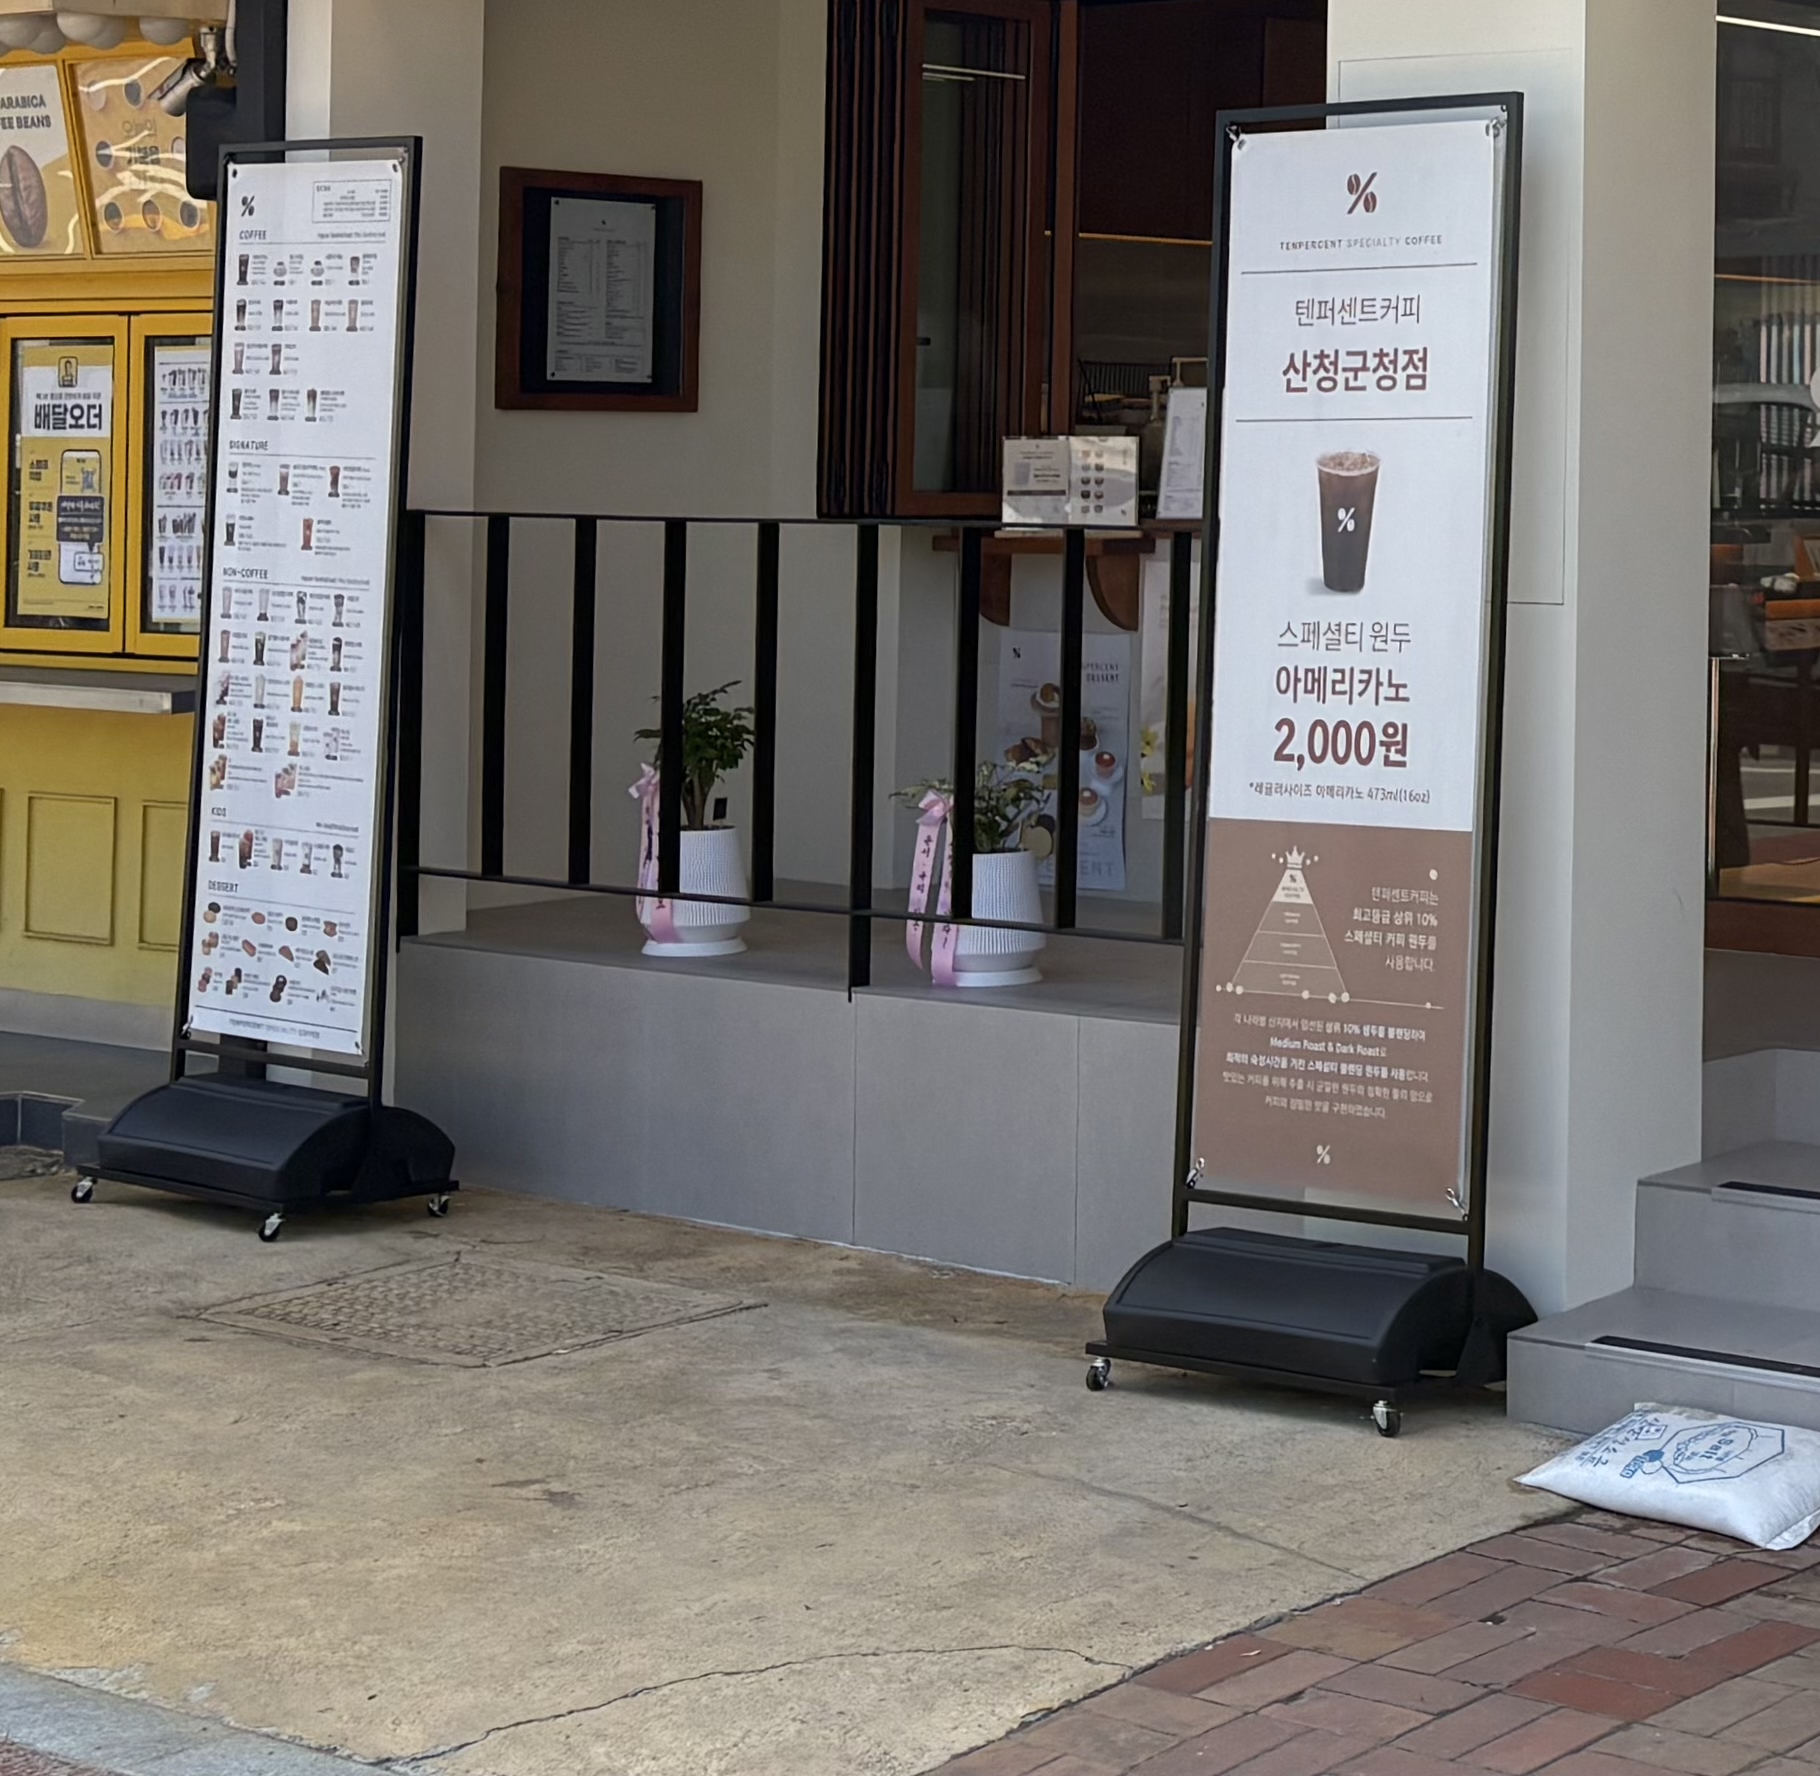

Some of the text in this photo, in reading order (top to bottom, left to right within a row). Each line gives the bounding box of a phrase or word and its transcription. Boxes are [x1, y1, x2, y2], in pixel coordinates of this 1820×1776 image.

[0, 94, 47, 110] ARABICA
[16, 114, 52, 129] BEANS
[239, 229, 267, 241] COFFEE
[1280, 234, 1443, 251] TENPERCENT SPECIALTY COFFEE
[1294, 293, 1421, 327] 텐퍼센트커피
[1282, 346, 1429, 394] 산청군청점
[34, 402, 103, 431] 배달오더
[229, 440, 269, 451] SIGNATURE
[223, 567, 269, 580] NON-COFFEE
[1277, 620, 1412, 654] 스페셜티 원두
[1275, 664, 1411, 707] 아메리카노
[1273, 717, 1409, 772] 2,000원
[1315, 784, 1364, 800] 아메리카노
[1367, 787, 1431, 805] 473ml(16oz)
[211, 806, 227, 818] KIDS
[208, 879, 239, 894] DESSERT
[1393, 910, 1414, 926] 상위
[1416, 912, 1438, 927] 10%
[1385, 931, 1406, 948] 커피
[1269, 1036, 1302, 1049] Medium
[1303, 1039, 1326, 1053] Roast
[1335, 1042, 1355, 1054] Dark
[1700, 1437, 1734, 1462] Salt
